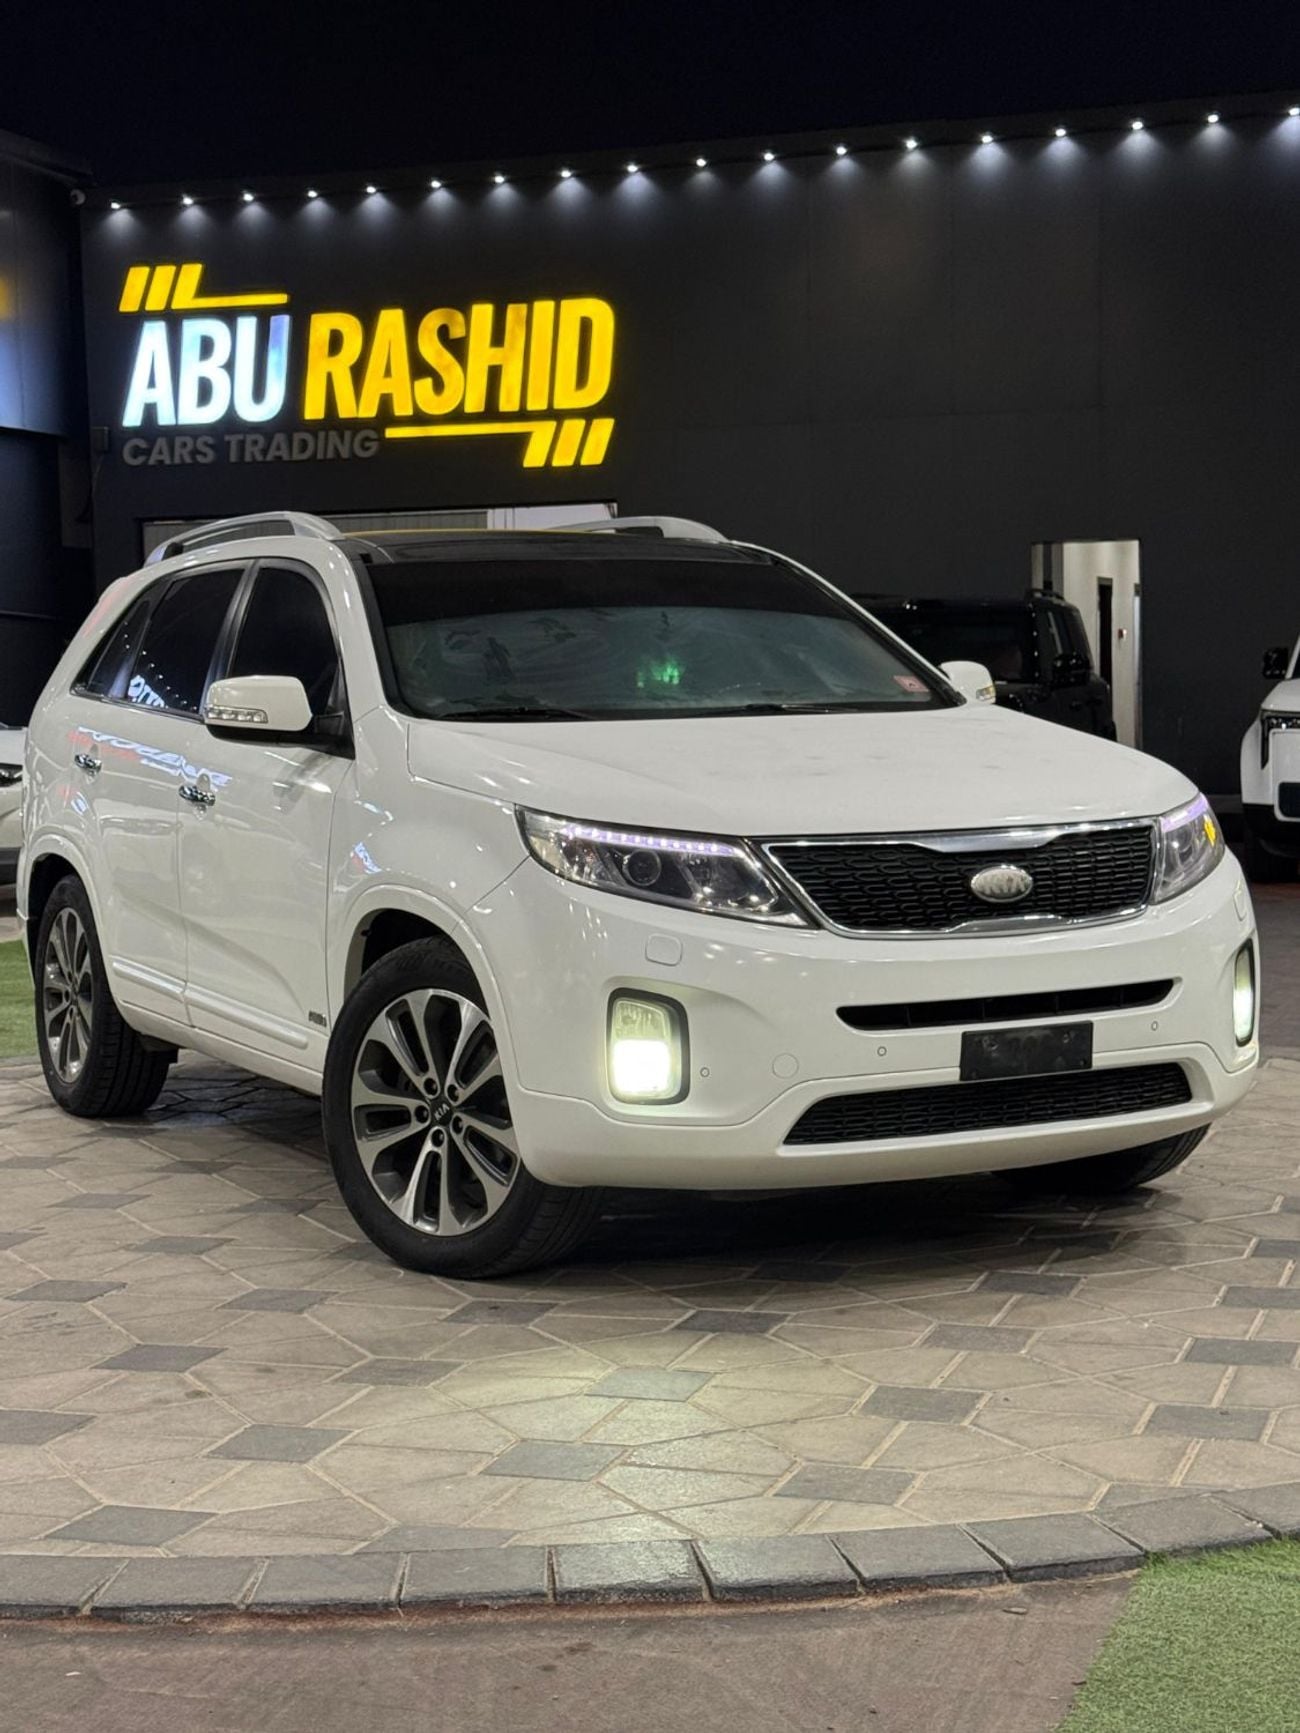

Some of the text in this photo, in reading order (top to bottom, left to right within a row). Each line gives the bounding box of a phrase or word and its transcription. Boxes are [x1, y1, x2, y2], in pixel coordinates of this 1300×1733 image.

[122, 298, 615, 427] ABU RASHID
[122, 429, 380, 467] CARS TRADING
[434, 1103, 450, 1121] KIA
